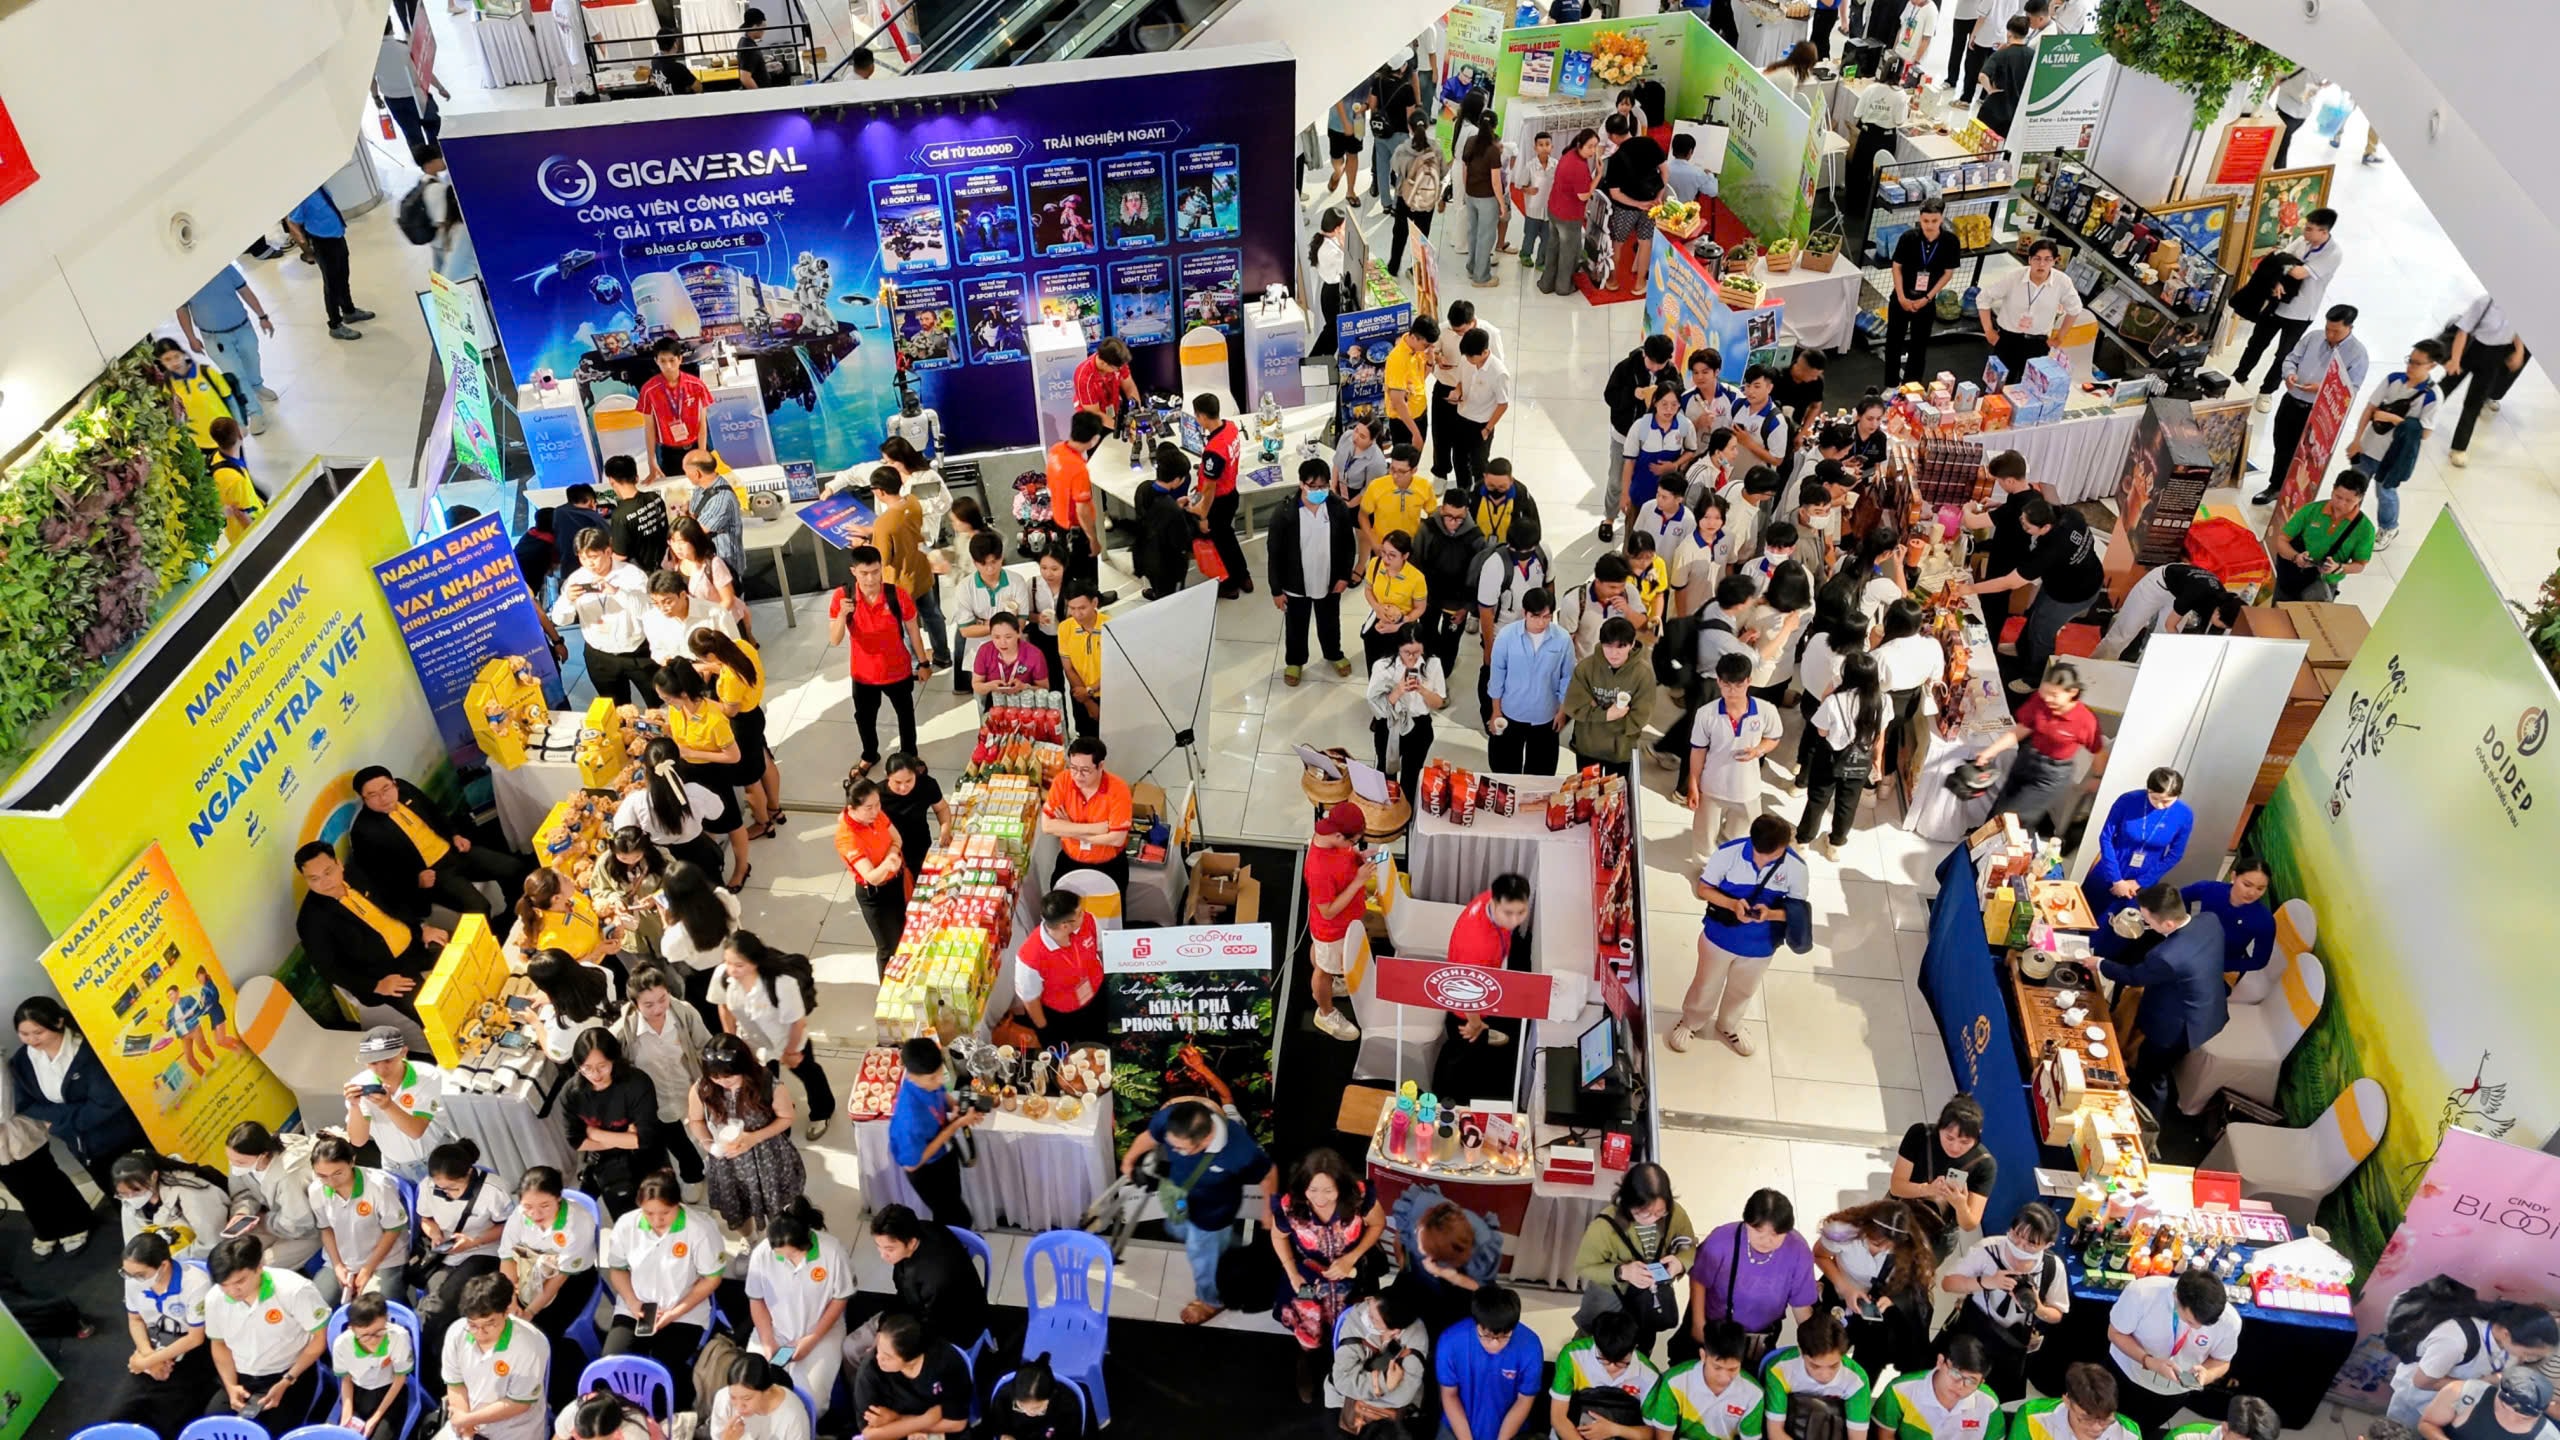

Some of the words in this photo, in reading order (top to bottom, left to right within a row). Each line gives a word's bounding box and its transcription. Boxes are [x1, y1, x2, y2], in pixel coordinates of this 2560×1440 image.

[2041, 53, 2081, 64] ALTAVIE
[1042, 136, 1072, 150] TRẢI
[1074, 130, 1125, 147] NGHIỆM
[1127, 127, 1166, 142] NGAY!
[930, 146, 949, 161] CHỈ
[950, 144, 966, 159] TỪ
[606, 145, 808, 188] GIGAVERSAL
[1132, 167, 1156, 176] WORLD
[889, 196, 915, 205] ROBOT
[916, 194, 932, 203] HUB
[984, 185, 1009, 194] WORLD
[577, 205, 633, 224] CÔNG
[638, 199, 680, 217] VIÊN
[686, 192, 738, 213] CÔNG
[743, 186, 796, 207] NGHỆ
[613, 221, 651, 240] GIẢI
[655, 216, 685, 235] TRÍ
[689, 218, 716, 233] ĐA
[645, 242, 675, 256] ĐẲNG
[677, 239, 699, 253] CẤP
[700, 237, 728, 250] QUỐC
[729, 235, 746, 247] TẾ
[1044, 284, 1065, 293] ALPHA
[1066, 282, 1091, 291] GAMES
[1120, 275, 1140, 284] LIGHT
[1141, 274, 1158, 283] CITY
[976, 291, 997, 300] SPORT
[1048, 380, 1073, 391] ROB
[380, 555, 429, 586] NAM
[432, 548, 447, 564] A
[446, 521, 501, 557] BANK
[394, 589, 434, 618] VAY
[440, 554, 514, 600] NHANH
[401, 614, 431, 633] KINH
[432, 596, 471, 619] DOANH
[472, 584, 494, 602] BỨT
[495, 572, 519, 590] PHÁ
[409, 635, 434, 651] Dành
[434, 628, 452, 640] cho
[452, 619, 468, 632] KH
[467, 606, 496, 626] Doanh
[496, 593, 527, 613] nghiệp
[185, 656, 239, 727] NAM
[239, 640, 256, 667] A
[252, 574, 310, 647] BANK
[210, 701, 232, 728] Ngân
[231, 680, 251, 704] hàng
[249, 660, 267, 682] Đẹp
[268, 638, 287, 660] Dịch
[285, 627, 295, 641] vụ
[294, 611, 307, 630] Tốt
[223, 723, 252, 757] HÀNH
[251, 690, 276, 723] PHÁT
[274, 661, 301, 695] TRIỂN
[317, 610, 342, 641] VỮNG
[188, 728, 278, 849] NGÀNH
[274, 675, 323, 737] TRÀ
[319, 612, 368, 680] VIỆT
[2482, 724, 2533, 811] DOIDEP
[1484, 780, 1497, 813] LANDS
[1504, 785, 1516, 818] LANDS
[61, 918, 98, 958] NAM
[98, 908, 110, 922] A
[109, 866, 150, 910] BANK
[72, 964, 94, 992] MỞ
[93, 941, 118, 968] THẺ
[139, 889, 170, 926] DỤNG
[93, 956, 122, 988] NAM
[123, 947, 133, 959] A
[133, 911, 164, 948] BANK
[1224, 945, 1257, 954] COOP
[1119, 981, 1165, 1001] Saigon
[1430, 969, 1497, 992] HIGHLANDS
[1148, 997, 1193, 1015] KHÁM
[1198, 995, 1230, 1014] PHÁ
[1437, 996, 1488, 1009] COFFEE
[1121, 1017, 1173, 1032] PHONG
[1232, 1009, 1259, 1030] SẮC
[2452, 1194, 2560, 1240] BLOO
[2508, 1197, 2551, 1214] CINDY
